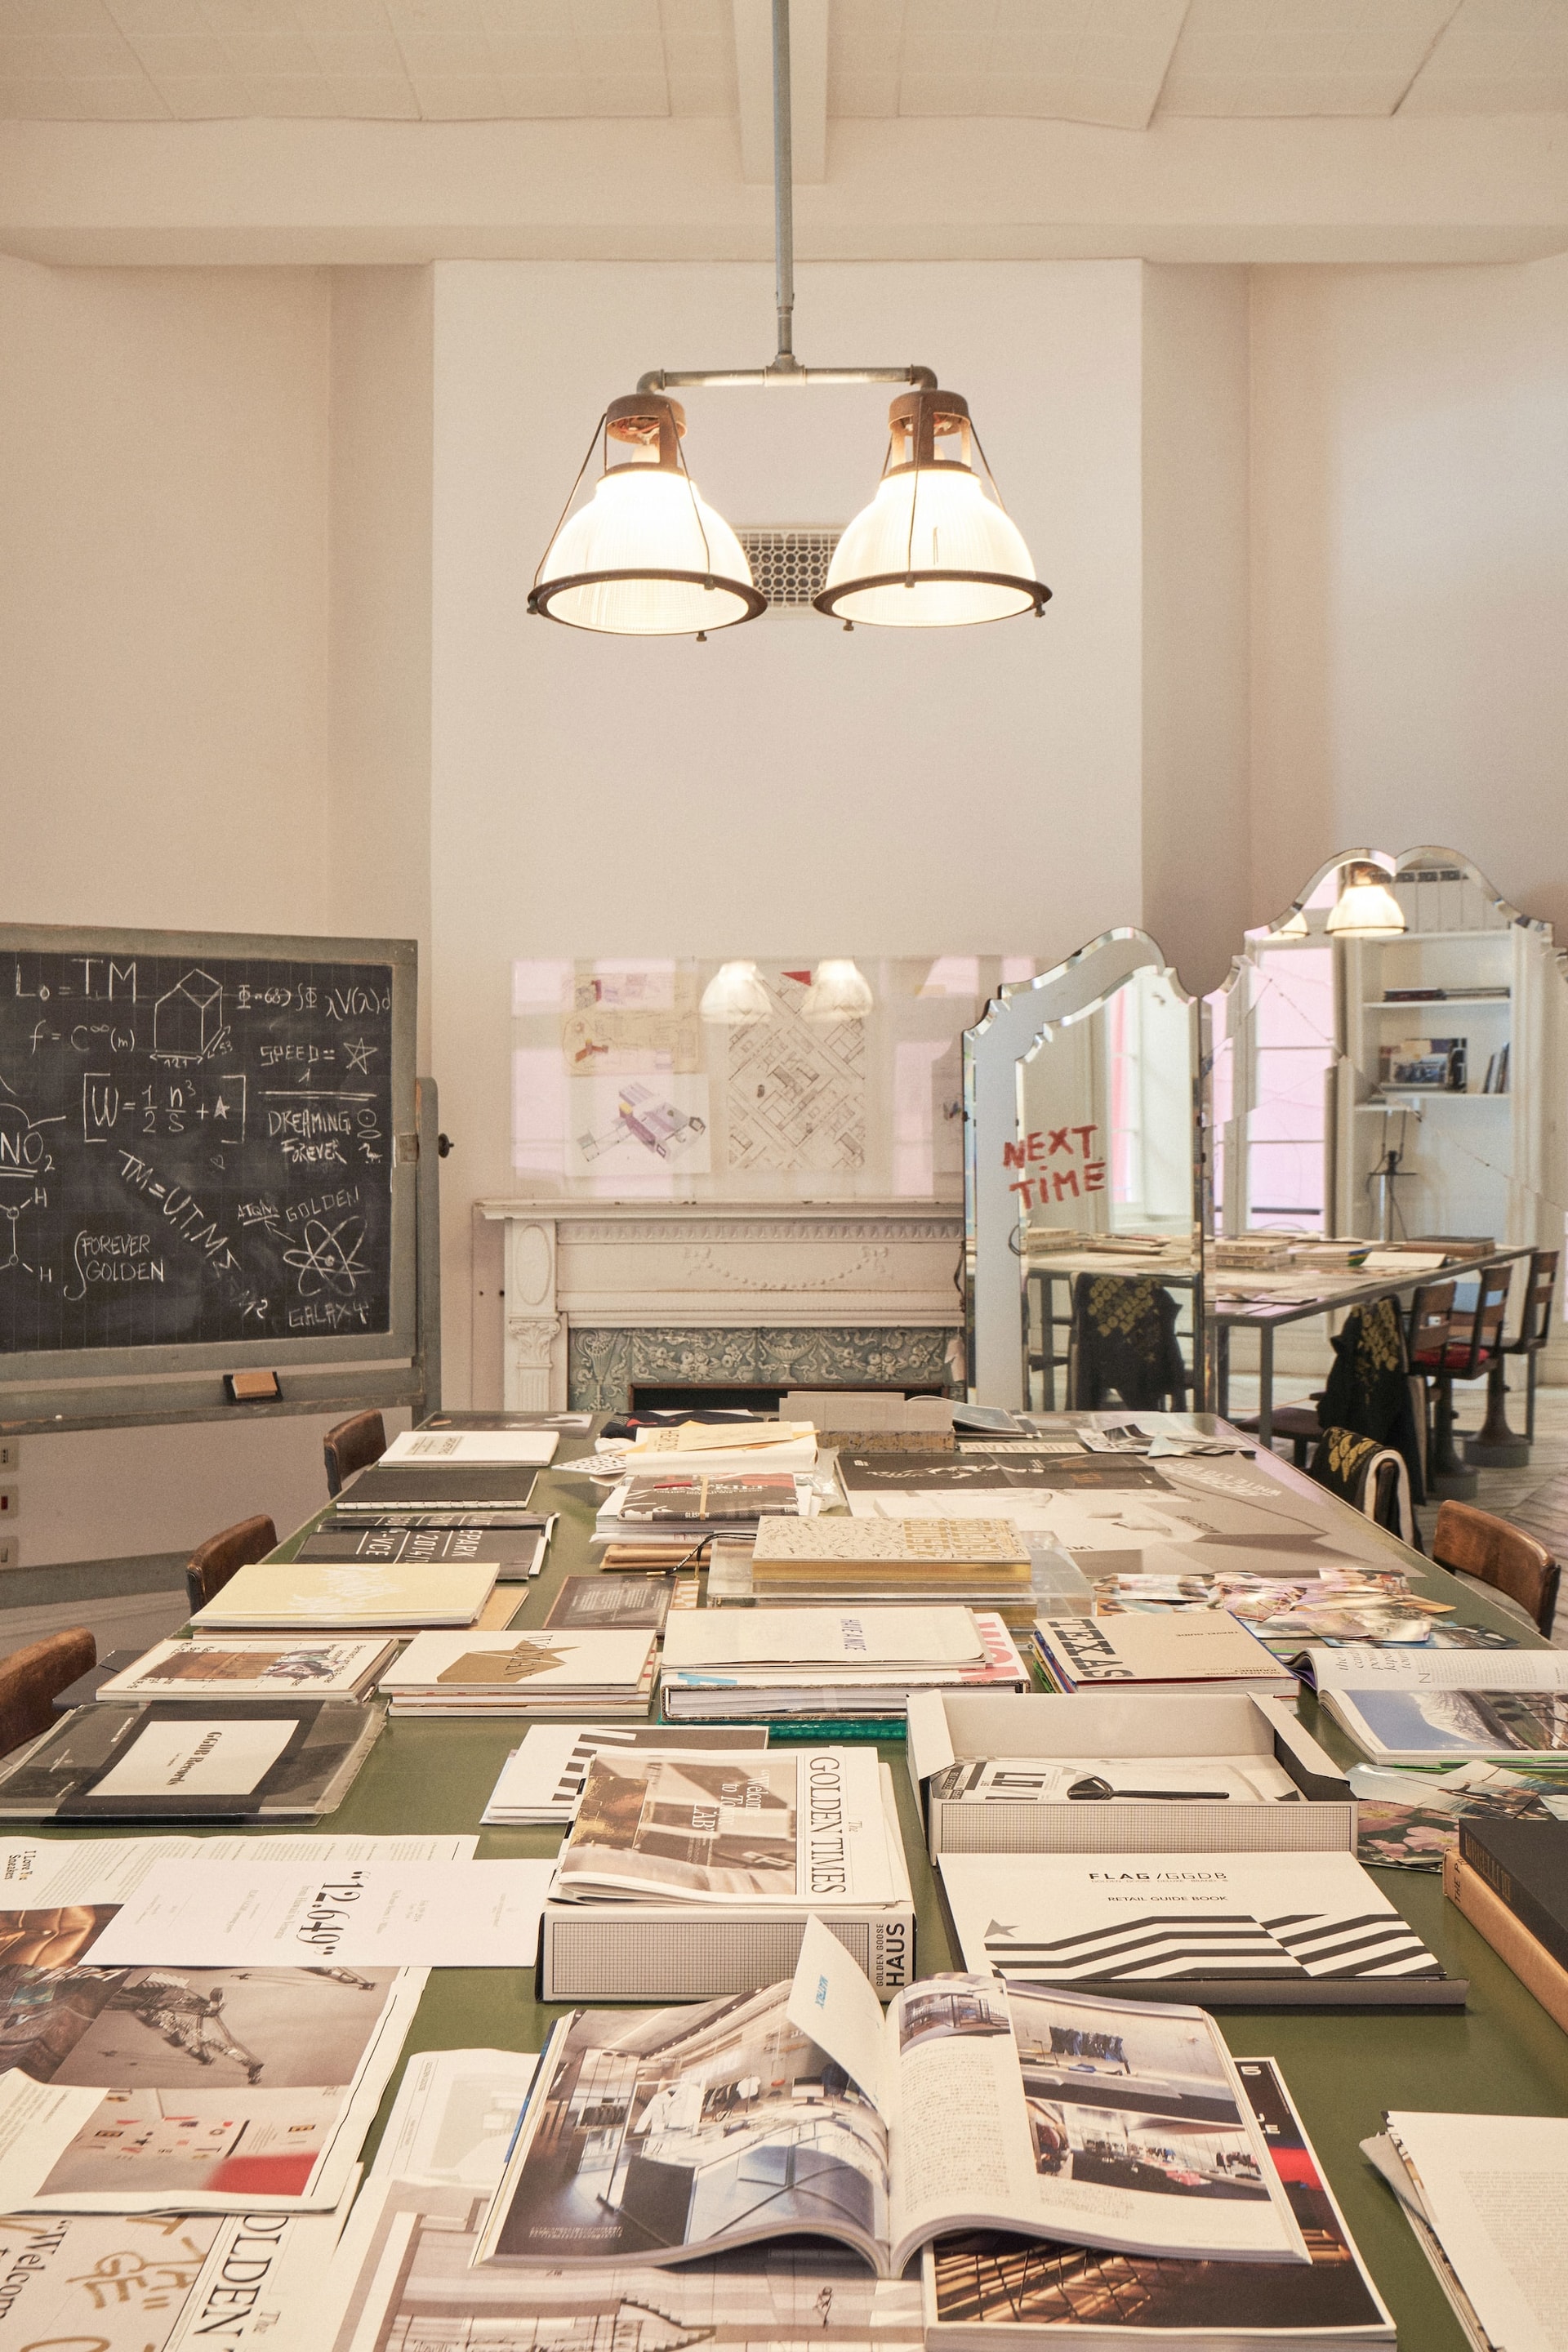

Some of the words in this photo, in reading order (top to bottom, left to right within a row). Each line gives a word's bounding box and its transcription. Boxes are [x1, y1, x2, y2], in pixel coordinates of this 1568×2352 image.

[260, 1045, 319, 1066] SPEED
[268, 1109, 351, 1138] DREAMING
[281, 1138, 347, 1164] FOREVER
[1003, 1124, 1098, 1170] NEXT
[286, 1185, 359, 1223] GOLDEN
[82, 1234, 150, 1257] FOREVER
[86, 1258, 164, 1282] GOLDEN
[840, 1619, 863, 1633] HAVE
[844, 1638, 866, 1651] NICE
[1047, 1619, 1136, 1678] TEXAS
[194, 1731, 223, 1756] GGDB
[166, 1757, 205, 1786] Records
[809, 1757, 843, 1833] GOLDEN
[4, 1854, 21, 1880] Sneakers
[21, 1855, 36, 1870] Love
[811, 1838, 846, 1894] TIMES
[875, 1922, 884, 1950] GOOSE
[875, 1950, 884, 1987] GOLDEN
[885, 1922, 906, 1987] HAUS
